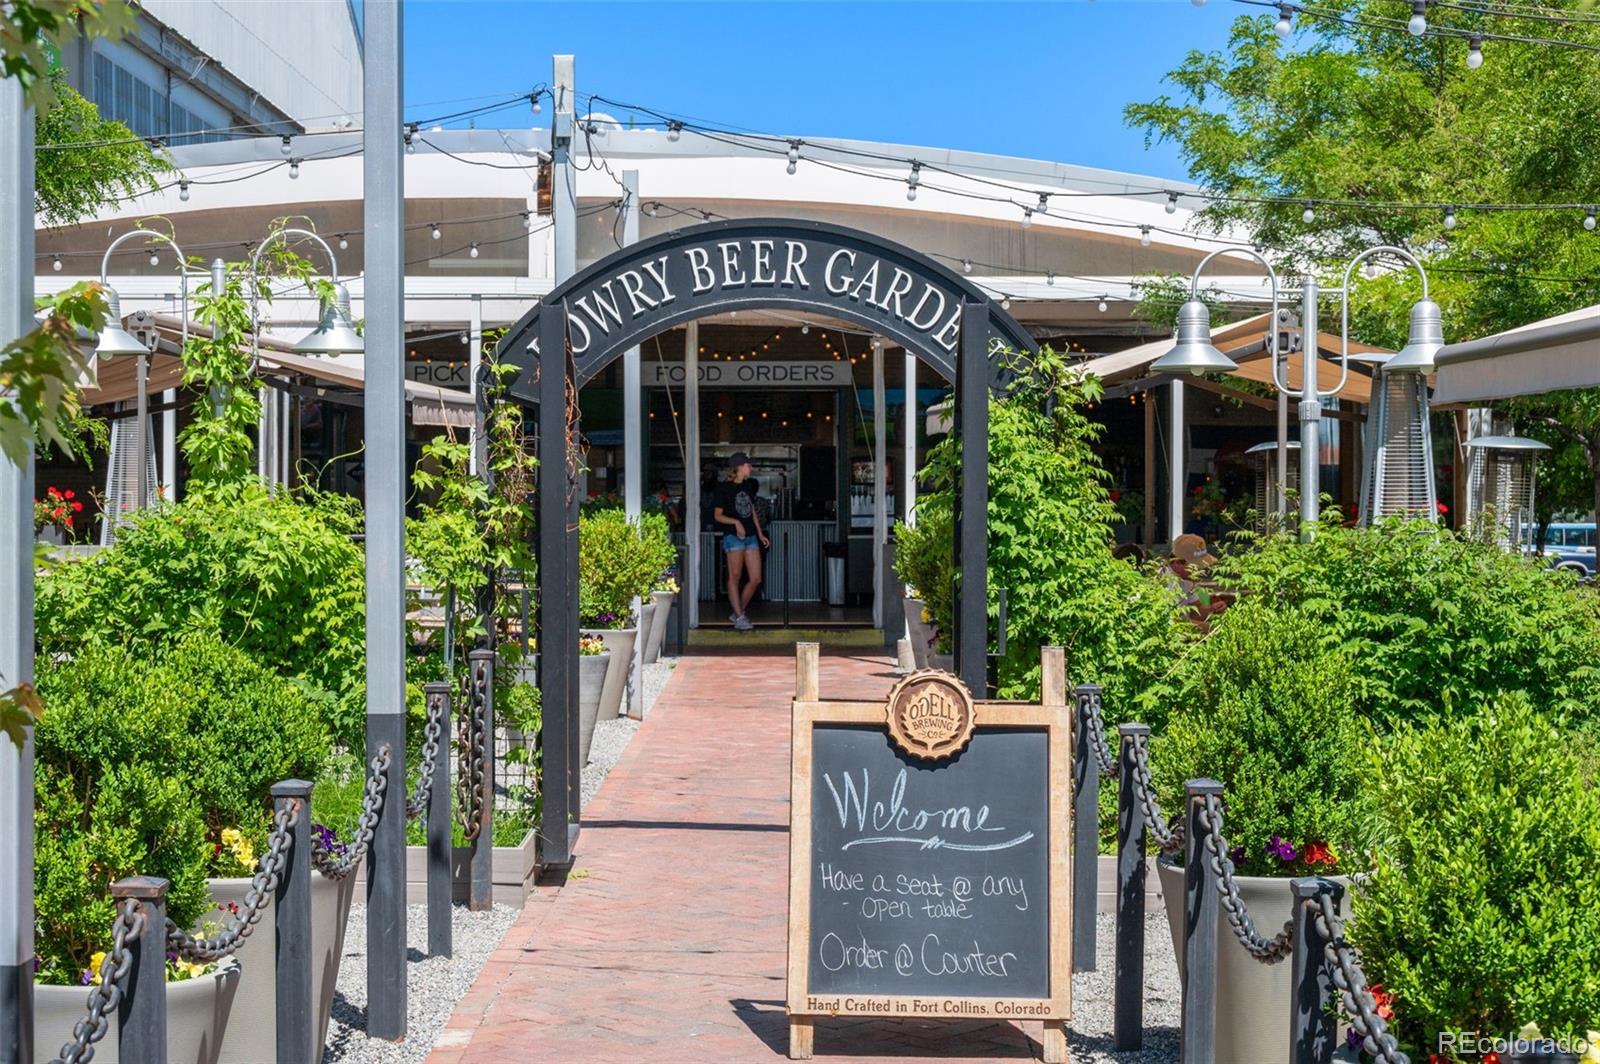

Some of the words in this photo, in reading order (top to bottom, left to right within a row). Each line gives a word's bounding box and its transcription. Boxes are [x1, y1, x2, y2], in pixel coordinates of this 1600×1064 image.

[684, 240, 810, 292] BEER
[413, 365, 465, 382] PICK
[737, 365, 834, 382] ORDERS
[909, 693, 954, 720] ODELL
[912, 718, 954, 731] BREWING
[824, 768, 1006, 832] Welcome
[821, 862, 864, 891] Have
[872, 874, 891, 893] a
[952, 876, 974, 902] @
[982, 872, 1029, 911] any
[922, 898, 973, 919] table
[819, 932, 888, 971] Order
[894, 943, 914, 976] @
[921, 933, 1018, 977] Counter
[807, 997, 840, 1011] Hand
[845, 998, 890, 1012] Crafted
[896, 1000, 908, 1012] in
[913, 1001, 938, 1013] Fort
[943, 1001, 990, 1015] Collins,
[994, 1002, 1051, 1015] Colorado
